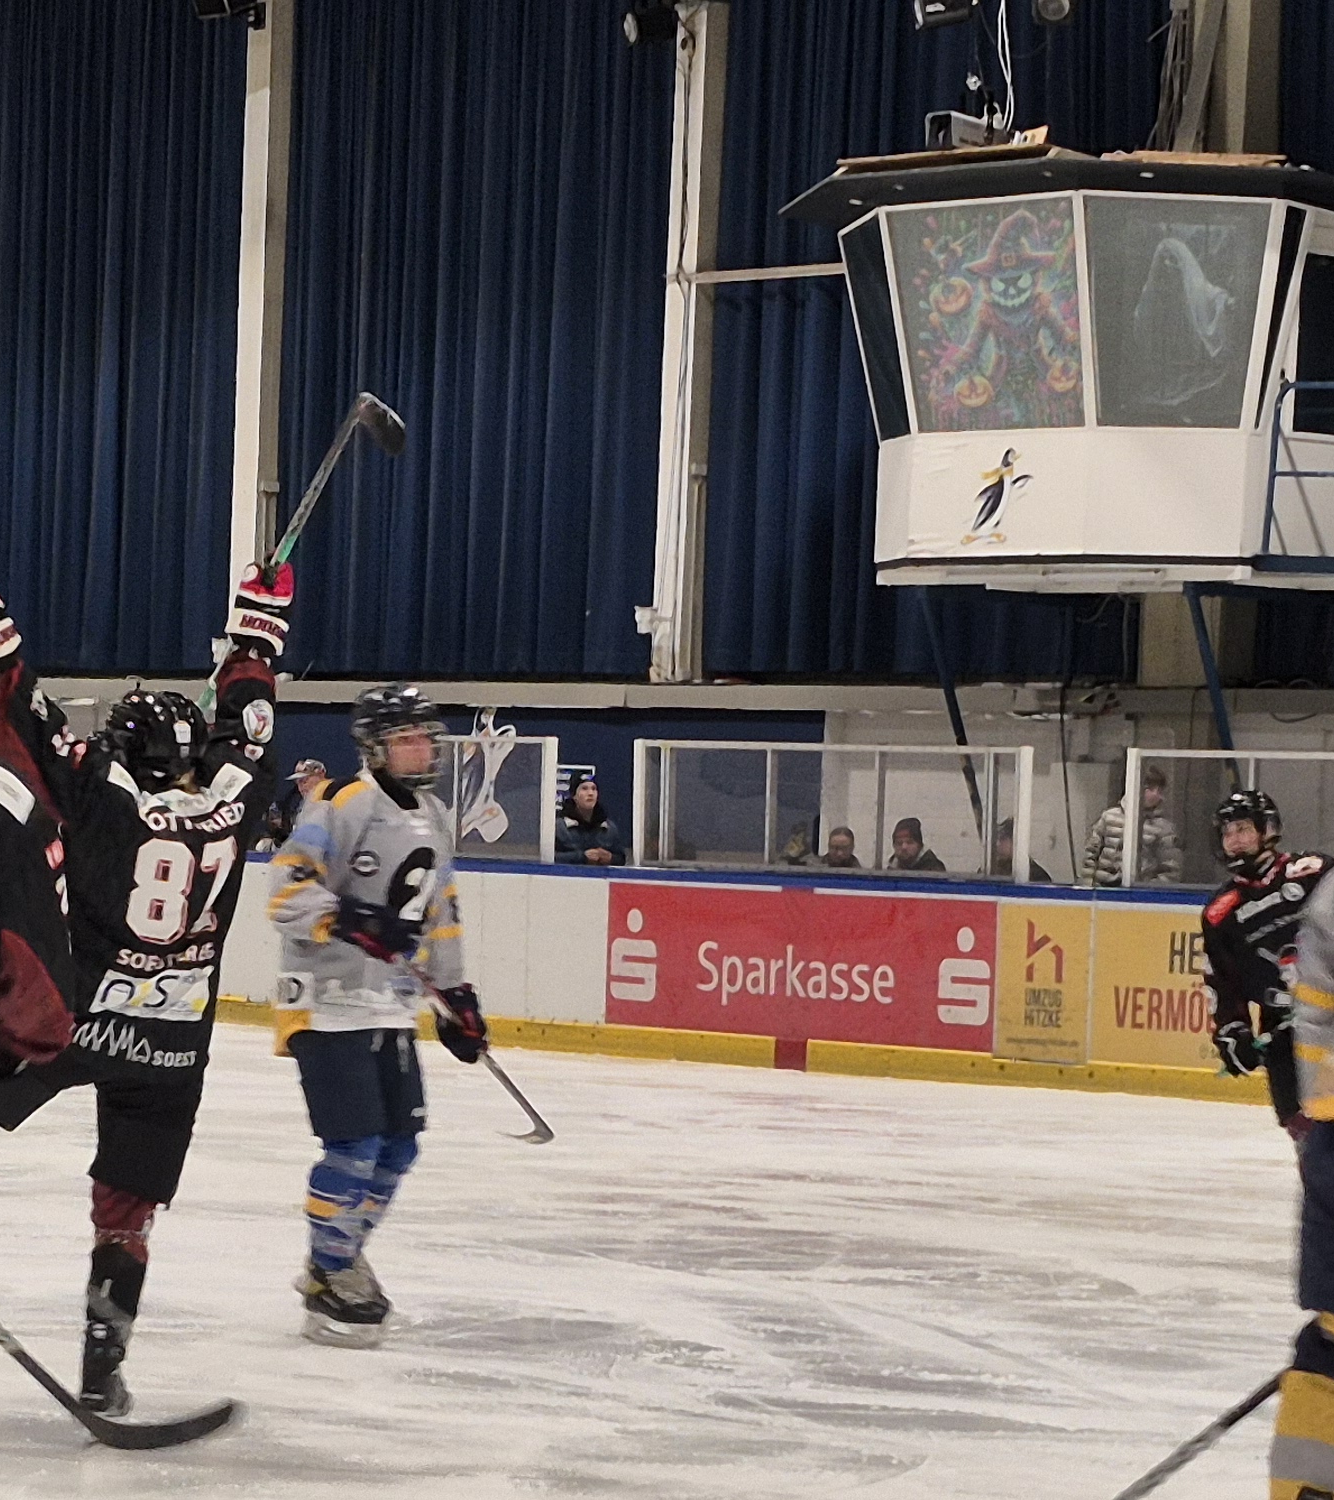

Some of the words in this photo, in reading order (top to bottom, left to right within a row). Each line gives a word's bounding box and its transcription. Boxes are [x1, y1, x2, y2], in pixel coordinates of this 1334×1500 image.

[125, 835, 240, 946] 87
[398, 867, 436, 921] 2
[696, 940, 895, 1006] Sparkasse
[1168, 930, 1207, 976] HE
[152, 1050, 198, 1068] SOEST
